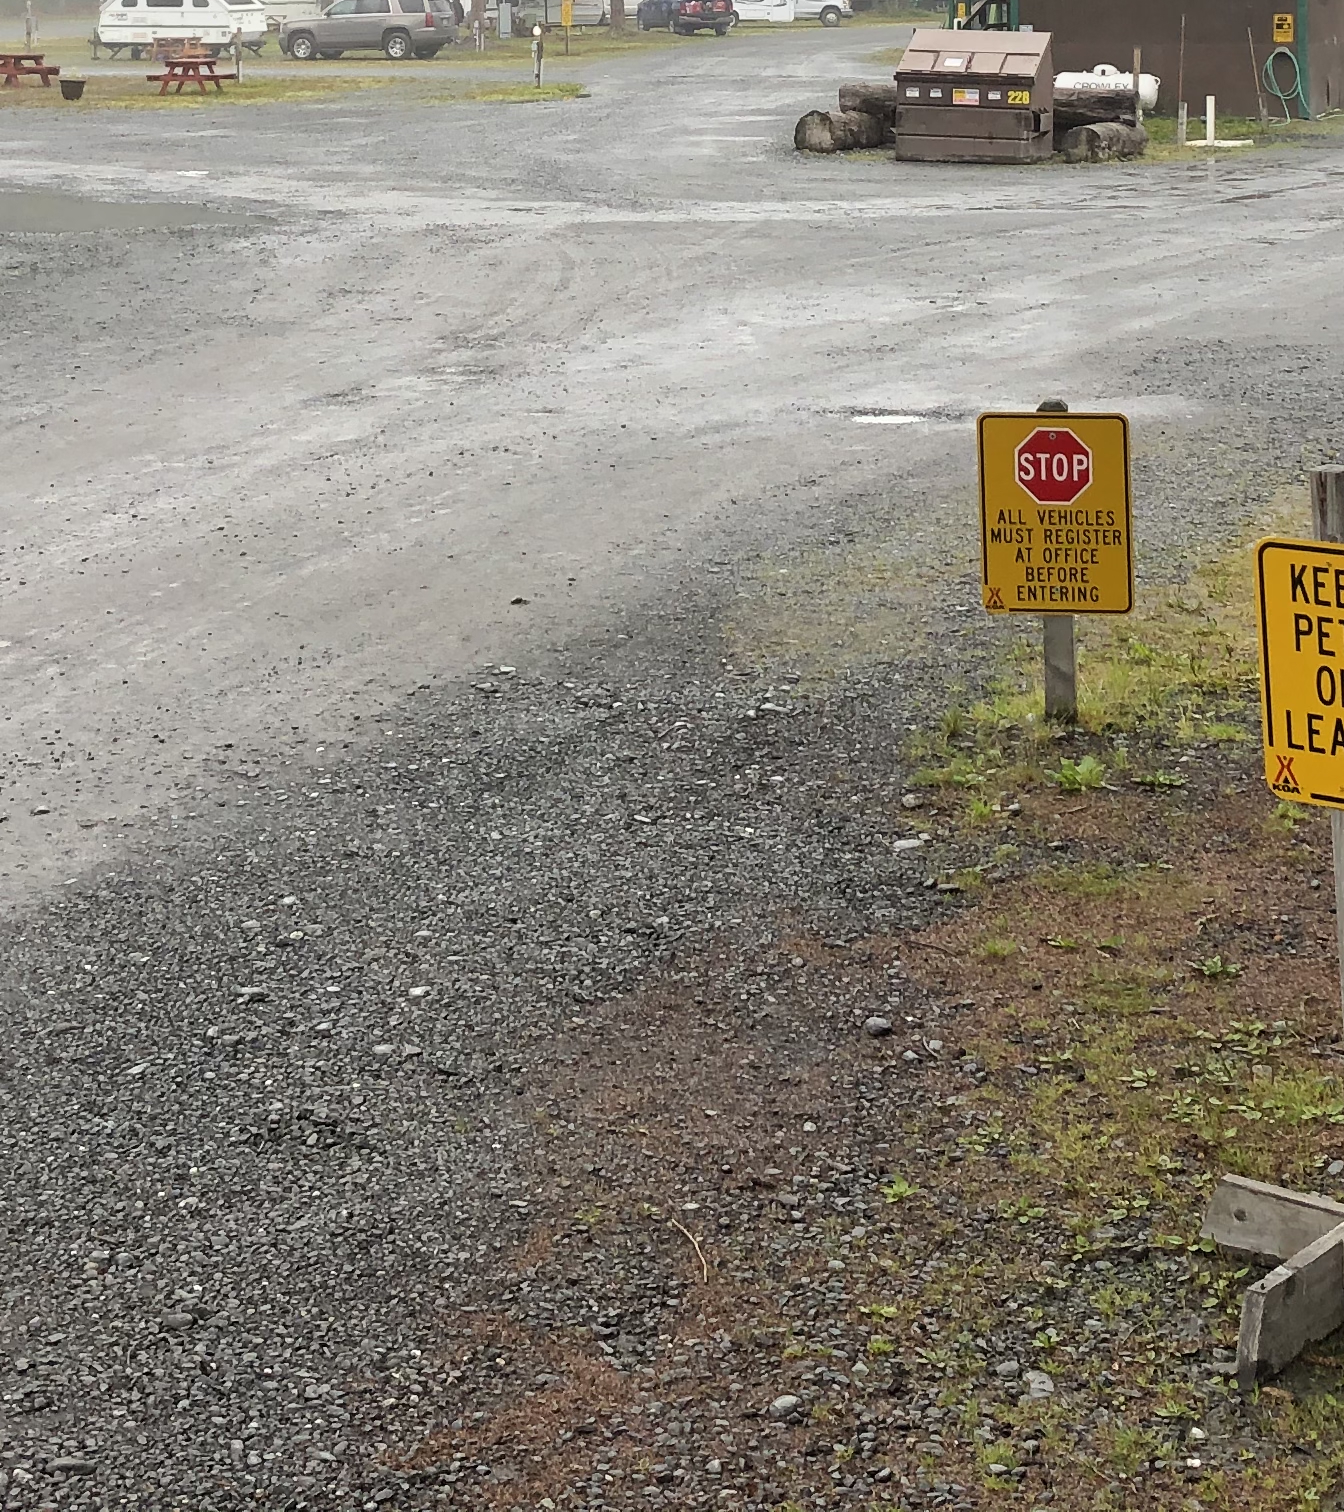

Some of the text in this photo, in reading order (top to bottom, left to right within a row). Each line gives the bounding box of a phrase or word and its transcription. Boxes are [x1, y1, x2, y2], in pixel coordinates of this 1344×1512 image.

[1007, 90, 1030, 104] 228
[1019, 453, 1088, 481] STOP
[997, 509, 1115, 526] ALL VEHICLES
[990, 528, 1122, 546] MUST REGISTER
[1015, 547, 1099, 564] AT OFFICE
[1025, 567, 1090, 583] BEFORE
[1017, 585, 1100, 602] ENTERING
[1272, 782, 1301, 795] KOA
